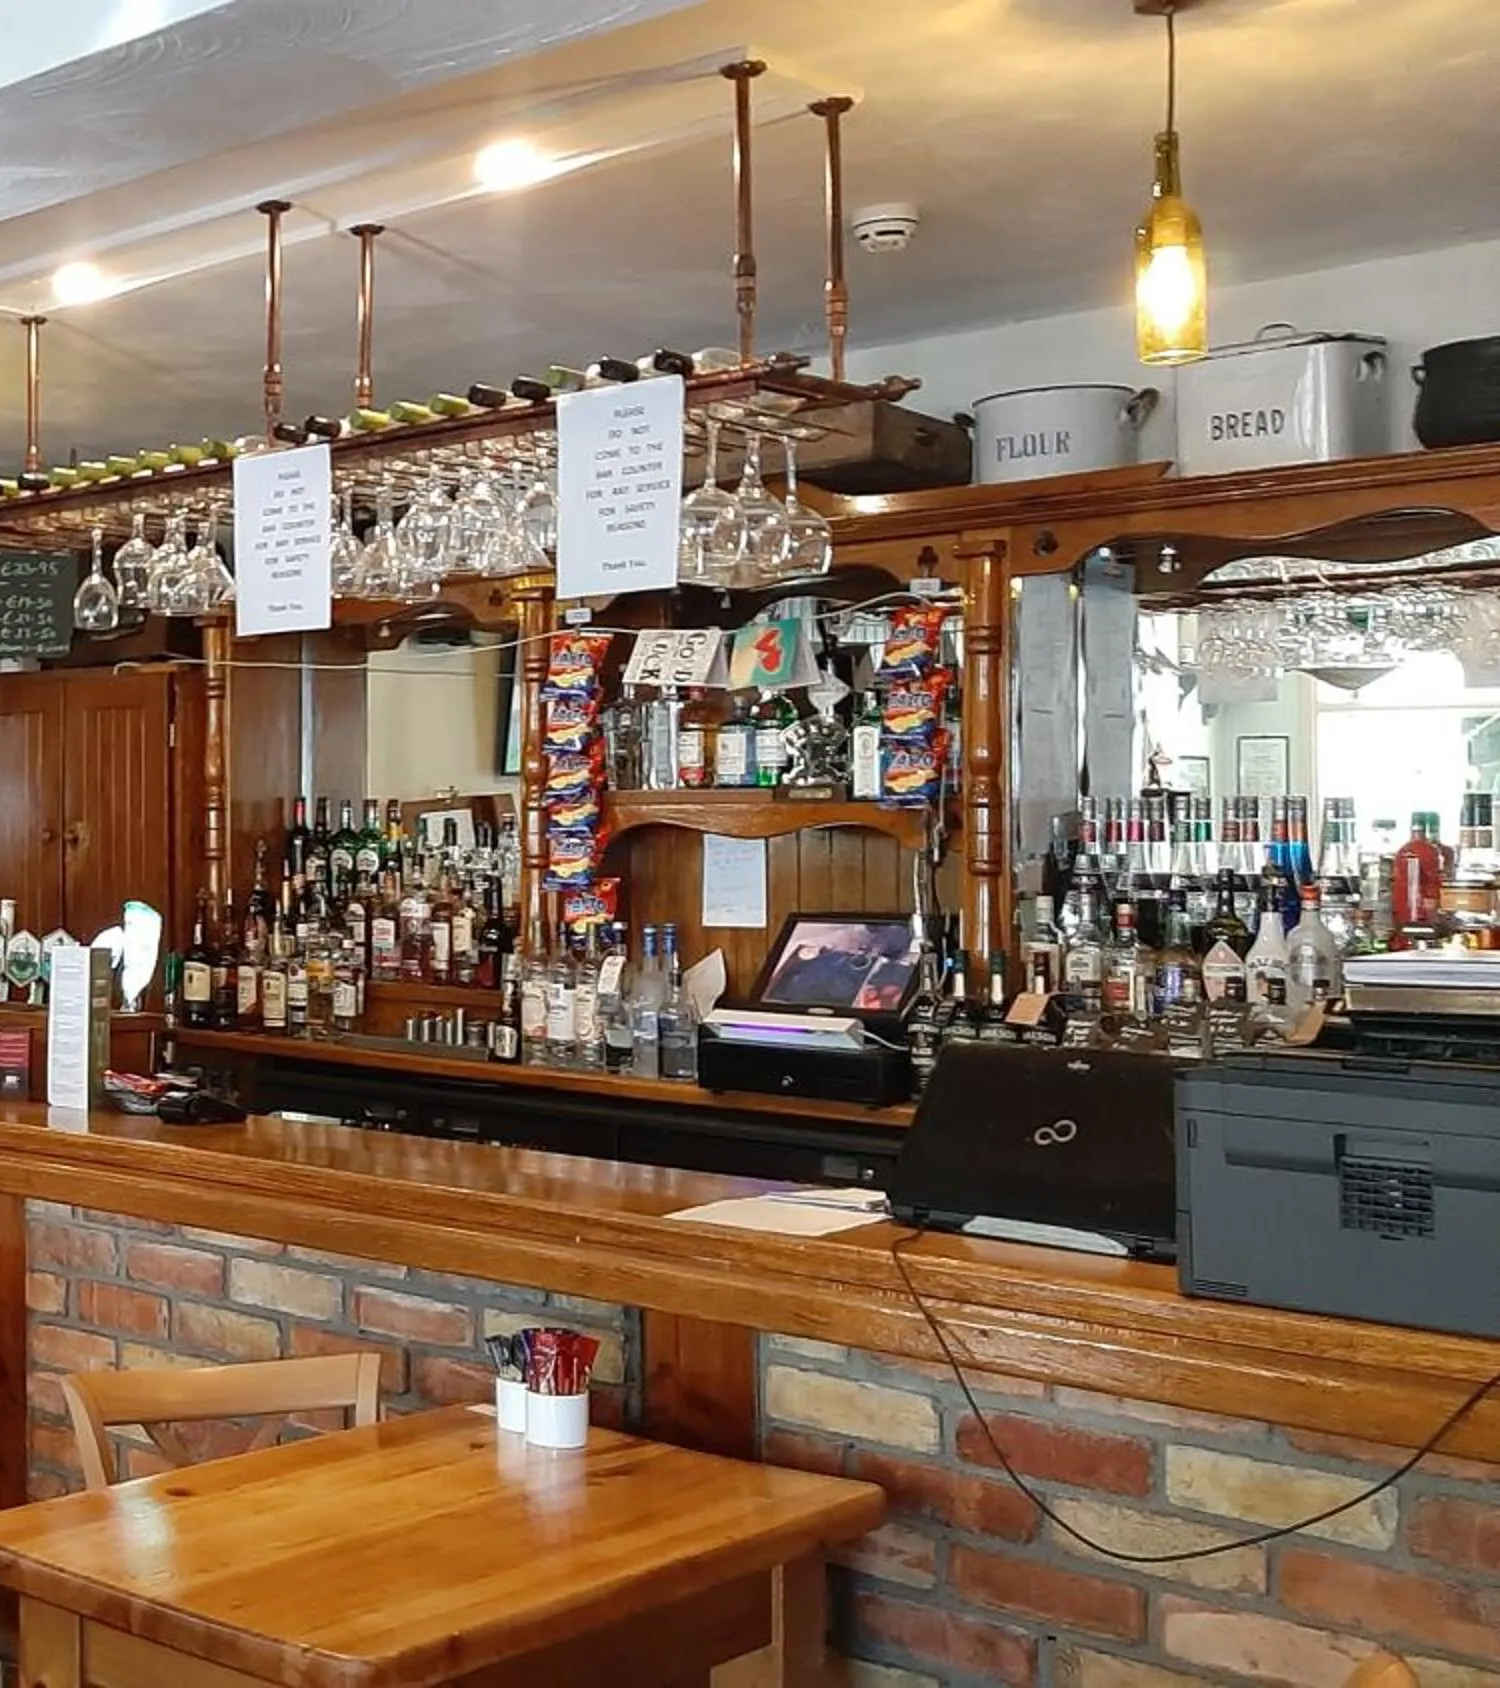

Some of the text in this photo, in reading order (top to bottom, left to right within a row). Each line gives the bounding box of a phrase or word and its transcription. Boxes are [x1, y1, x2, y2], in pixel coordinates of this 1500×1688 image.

[614, 406, 645, 418] PLEASE
[608, 425, 650, 439] DO NOT
[1210, 409, 1285, 440] BREAD
[594, 442, 663, 460] COME TO THE
[995, 431, 1070, 461] FLOUR
[596, 462, 663, 480] BAR COUNTER
[586, 480, 671, 500] FOR ANY SERVICE
[598, 507, 616, 518] FOR
